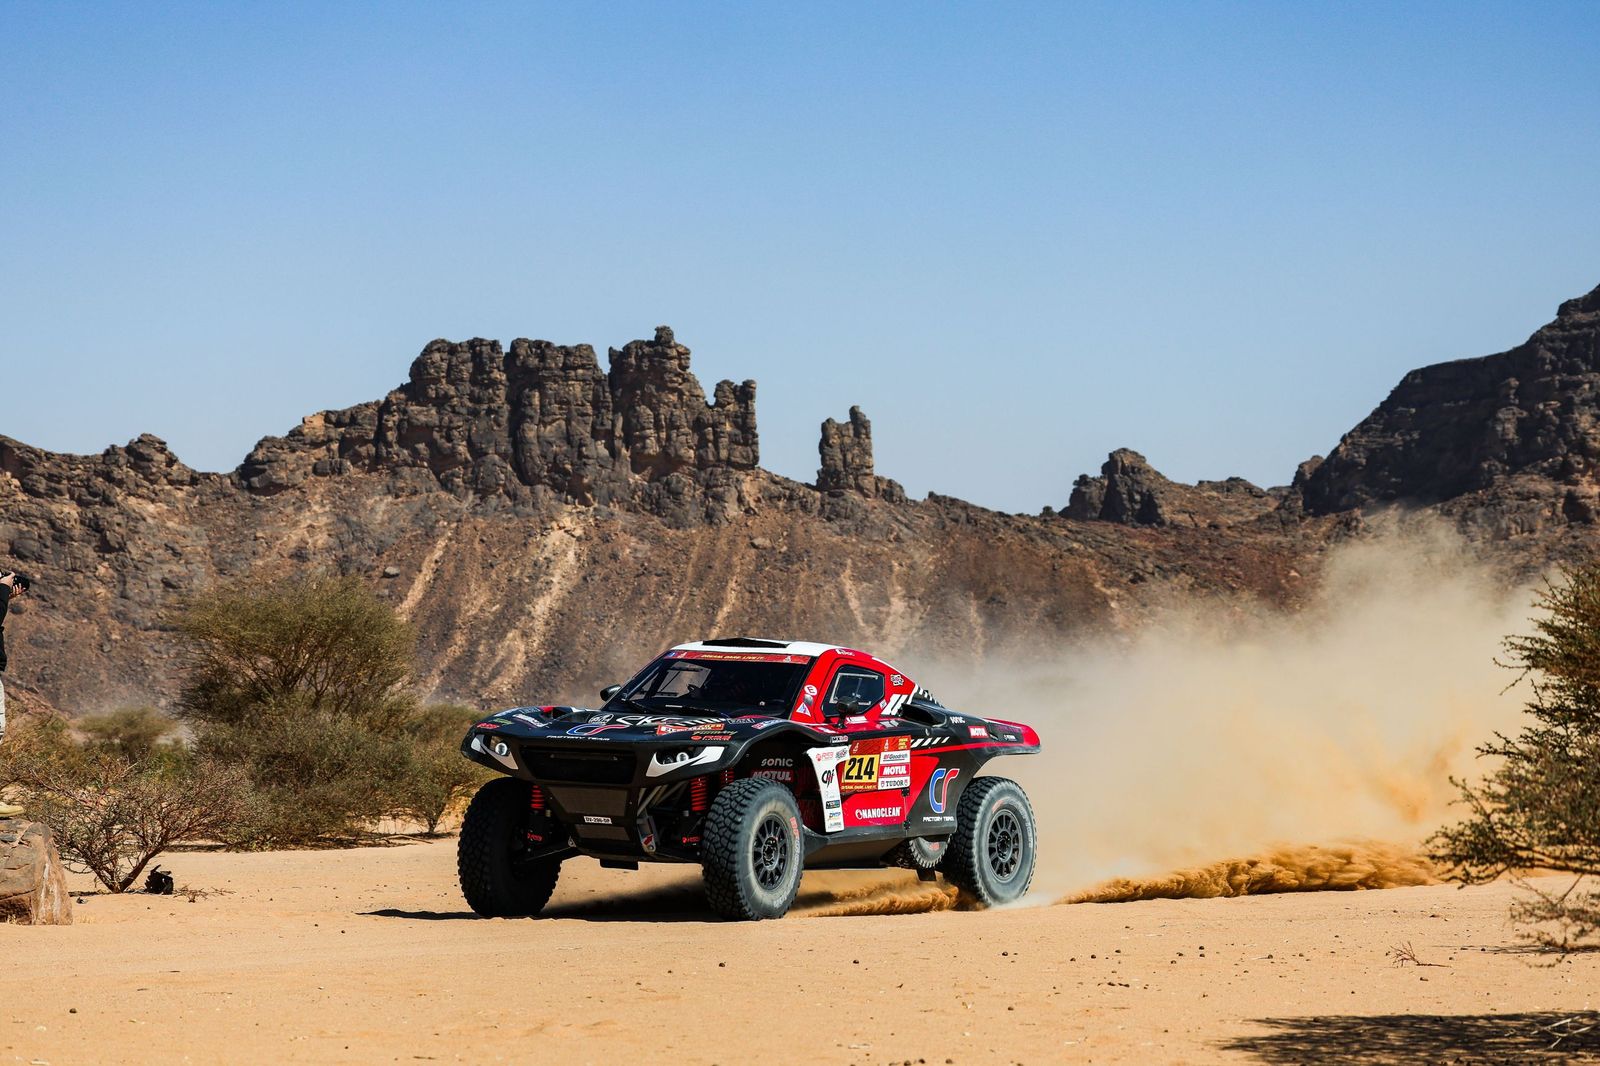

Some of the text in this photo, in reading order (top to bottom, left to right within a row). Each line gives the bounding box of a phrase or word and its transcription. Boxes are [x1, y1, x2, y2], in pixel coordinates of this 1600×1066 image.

[845, 757, 875, 780] 214
[883, 765, 907, 775] MOTUL
[752, 771, 791, 781] MOTUL
[886, 779, 904, 787] TUDOR
[862, 807, 901, 819] NANOCLEAN
